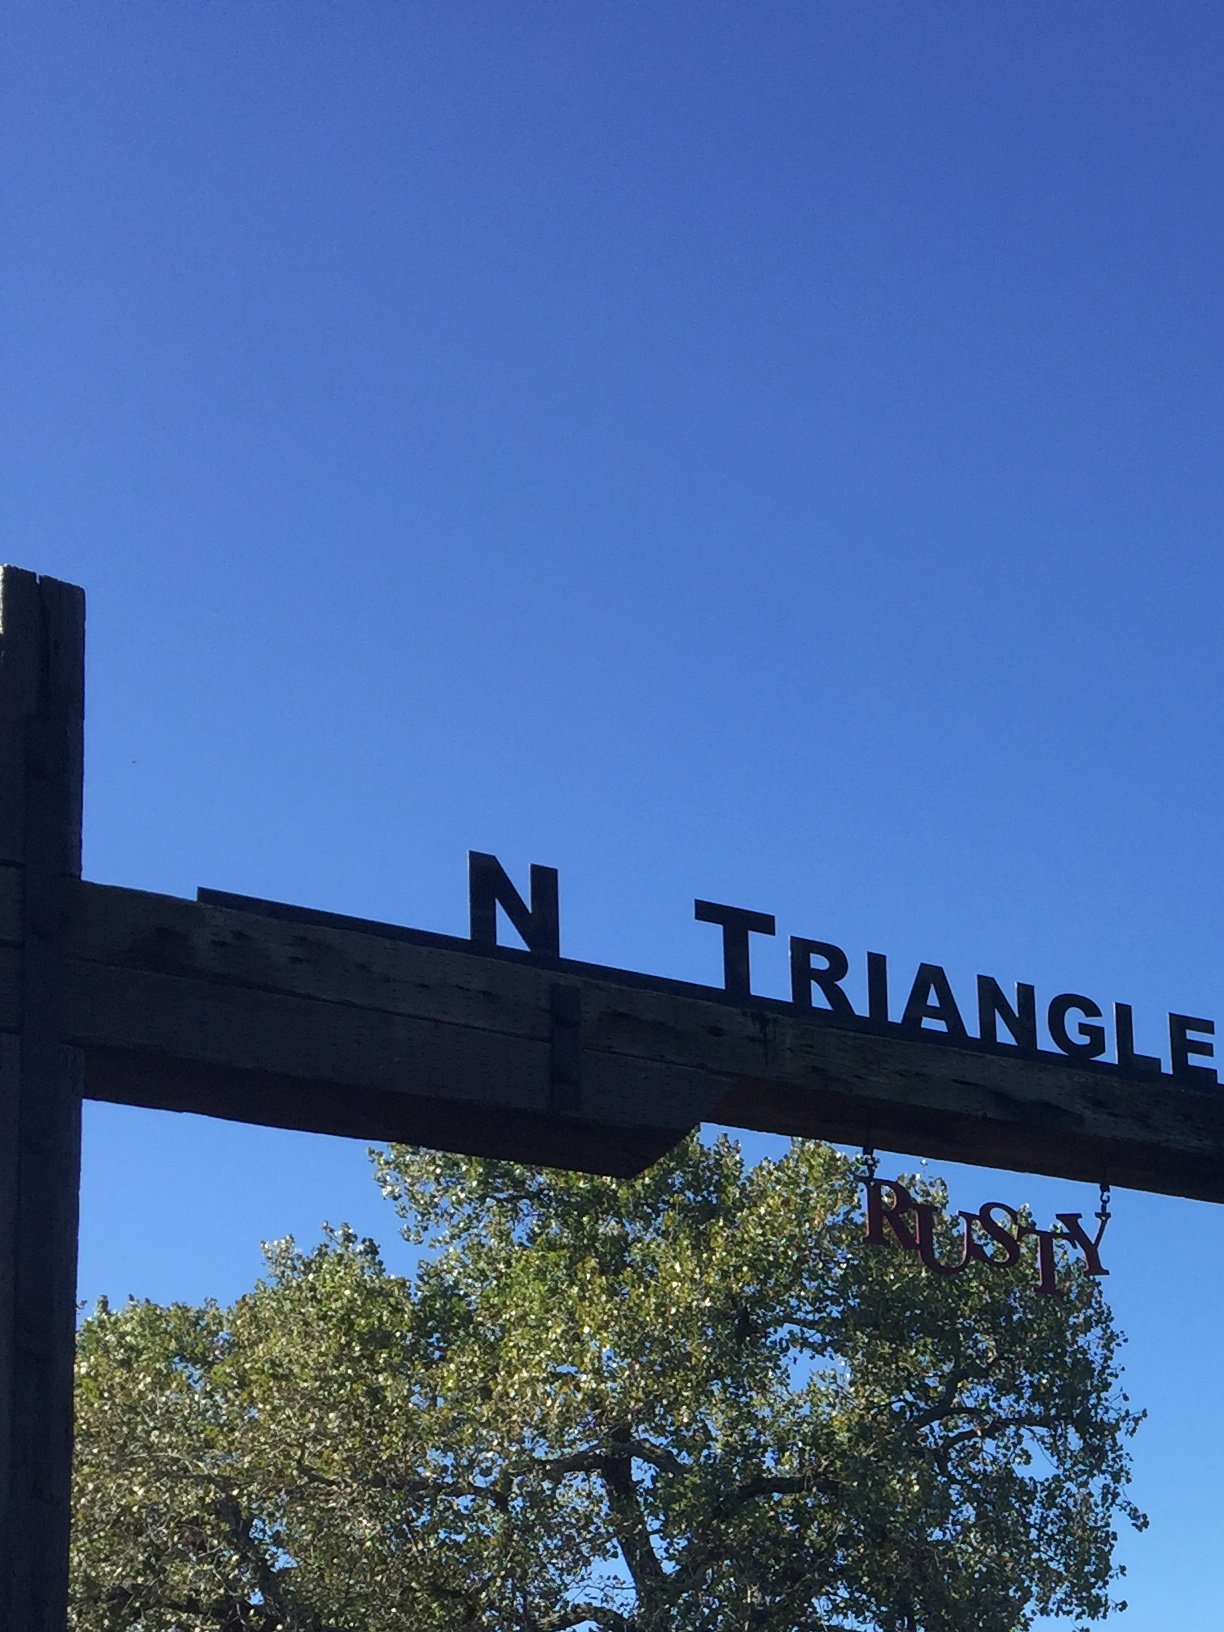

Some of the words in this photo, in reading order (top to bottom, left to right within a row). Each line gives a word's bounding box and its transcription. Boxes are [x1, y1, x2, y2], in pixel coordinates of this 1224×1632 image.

[468, 850, 560, 958] N
[694, 899, 1219, 1086] TRIANGLE
[860, 1176, 1110, 1294] RUSTY
